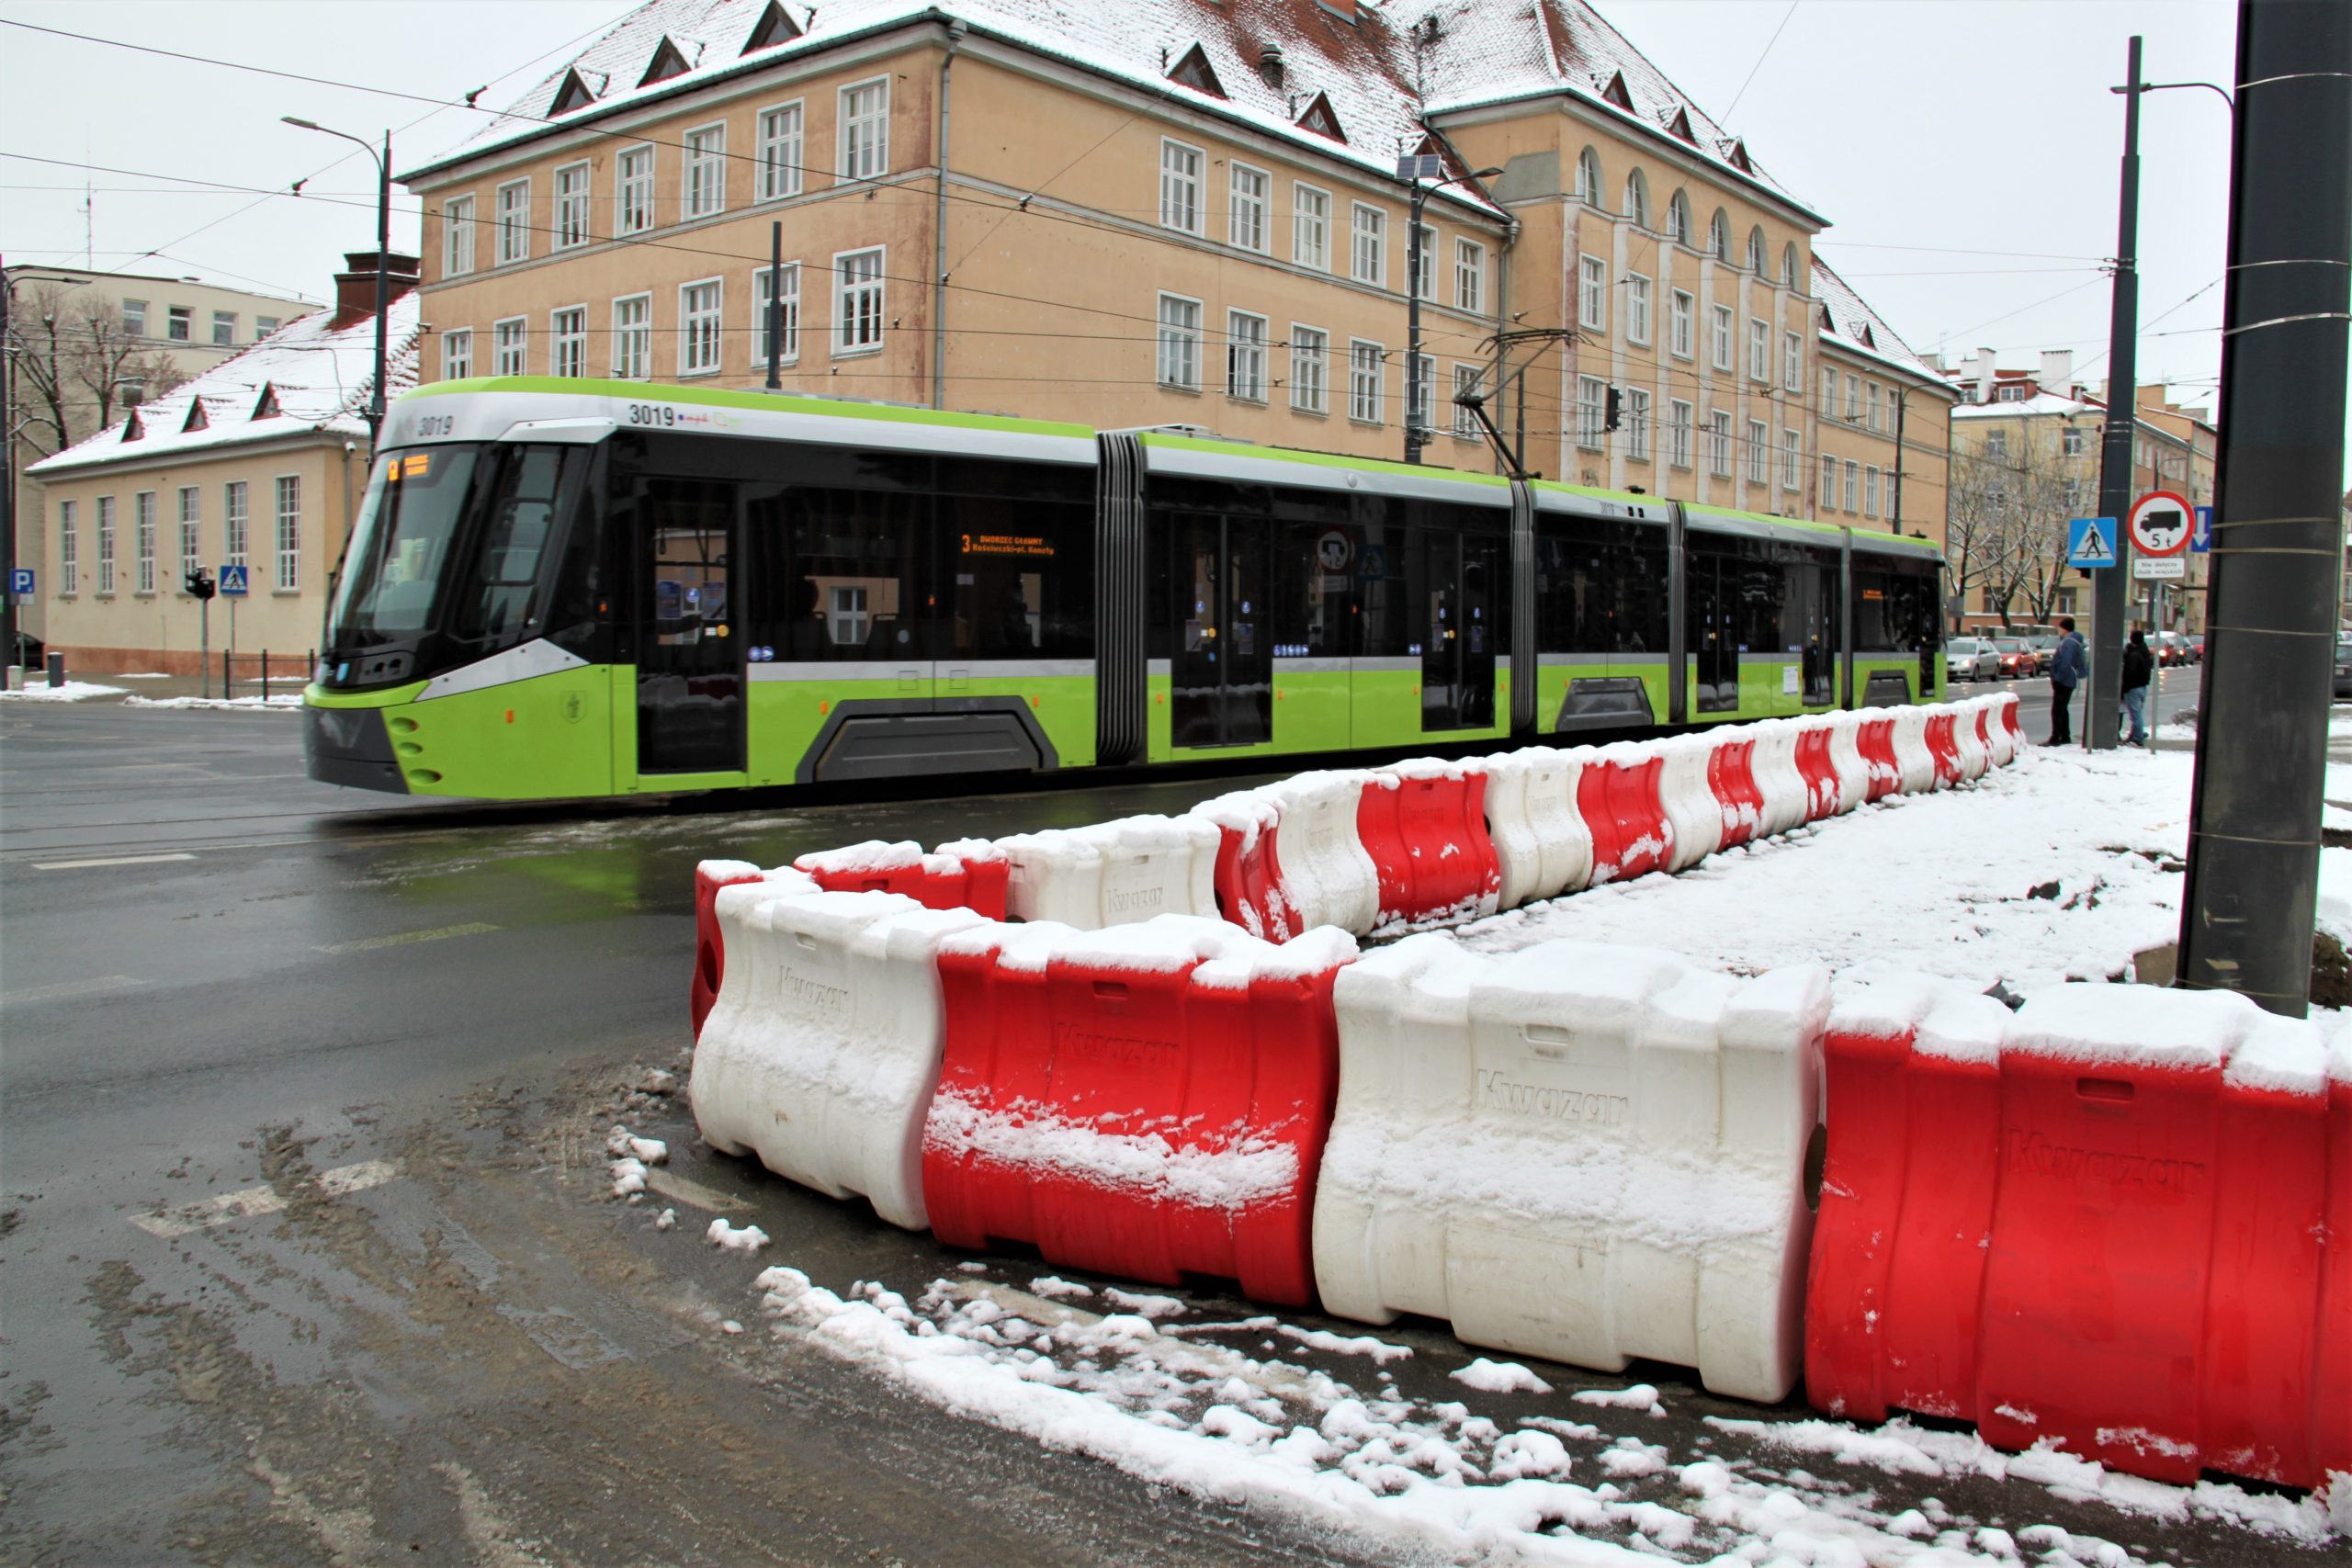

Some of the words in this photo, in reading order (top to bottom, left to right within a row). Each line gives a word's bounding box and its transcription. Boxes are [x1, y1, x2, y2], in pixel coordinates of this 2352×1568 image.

[418, 415, 454, 436] 3019
[629, 403, 674, 426] 3019
[962, 534, 970, 552] 3
[979, 535, 1012, 544] DWORZEC
[2152, 534, 2160, 547] 5
[2166, 536, 2171, 547] t
[16, 571, 30, 590] P
[1105, 886, 1163, 912] Kwazar
[779, 964, 849, 1013] Kwazar
[1055, 1021, 1180, 1068] Kwazar
[1476, 1068, 1629, 1123] Kwazar
[2007, 1129, 2205, 1195] Kwazar
